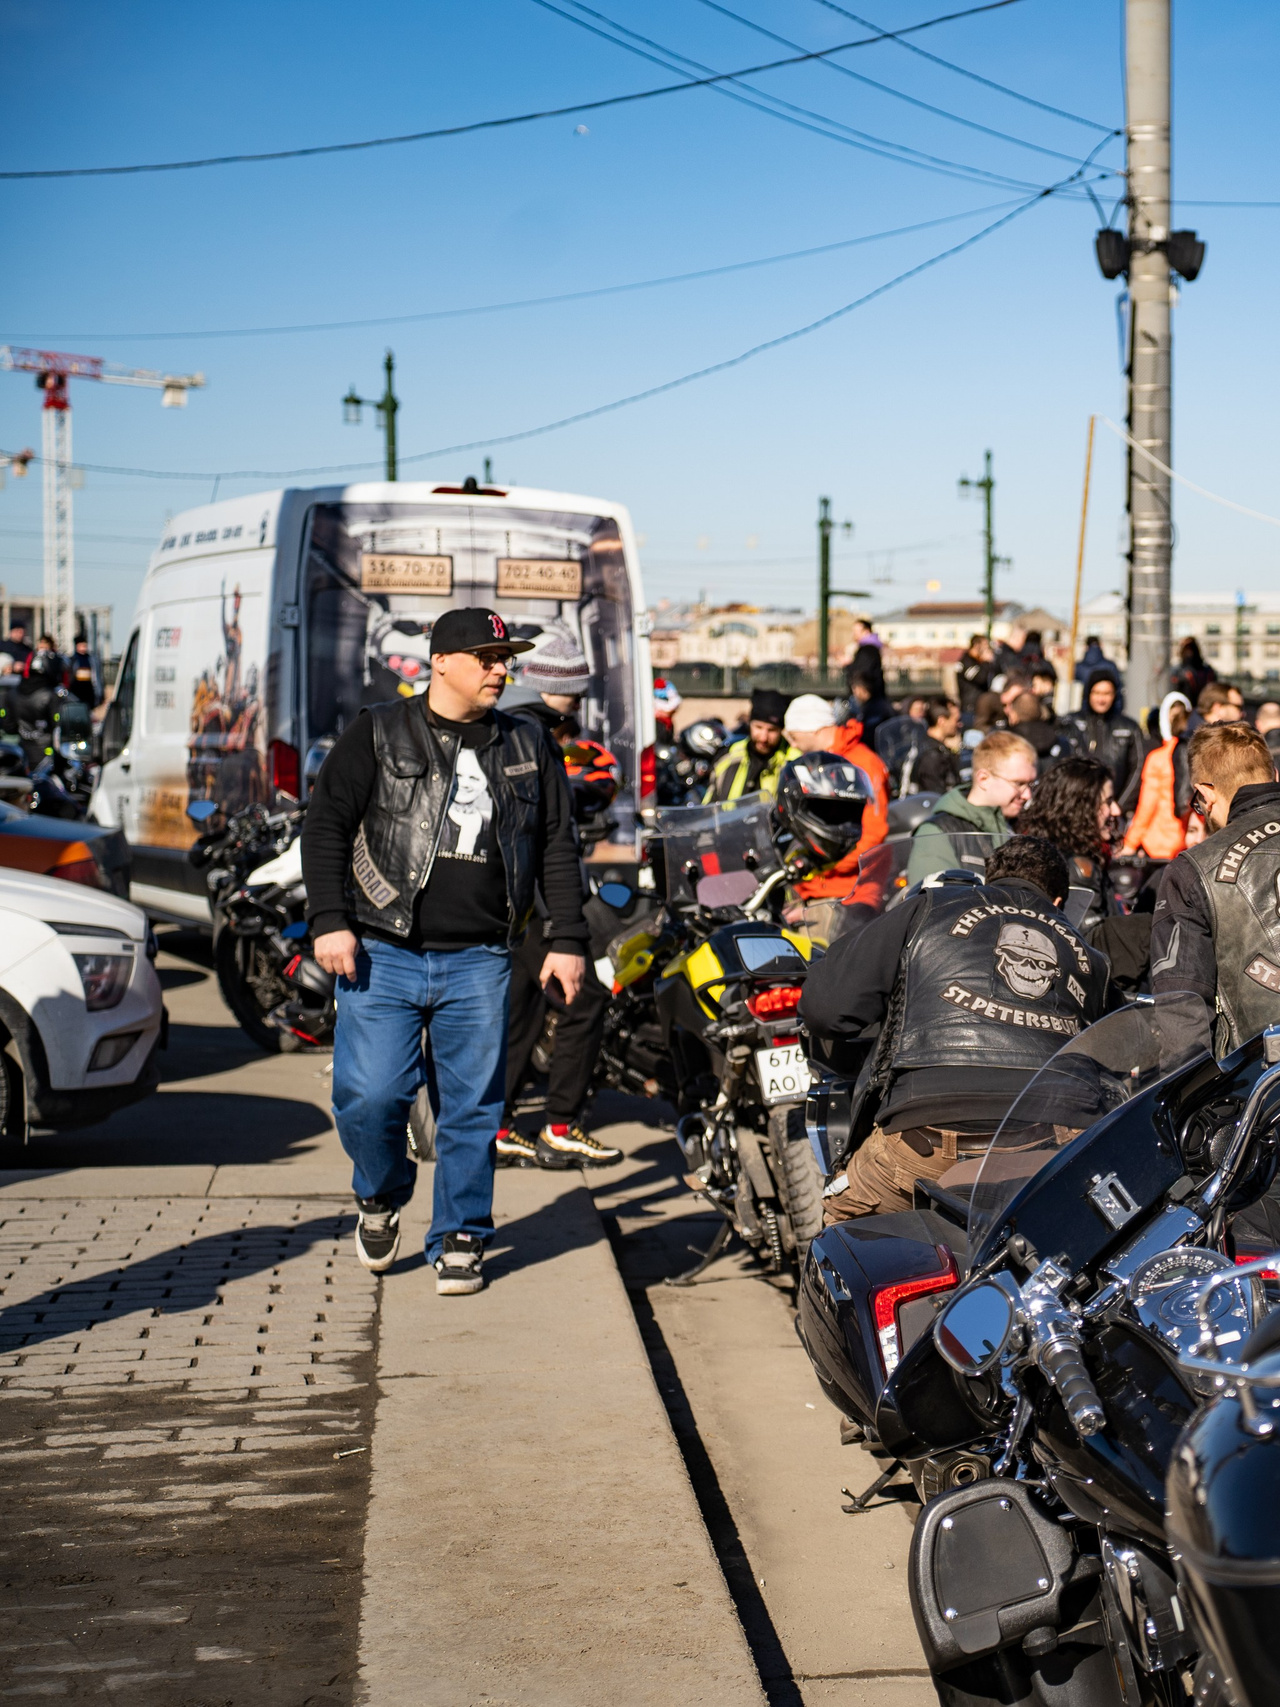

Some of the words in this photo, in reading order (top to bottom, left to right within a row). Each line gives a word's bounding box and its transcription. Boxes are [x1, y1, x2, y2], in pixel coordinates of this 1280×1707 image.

[1219, 843, 1250, 880] THE
[951, 908, 987, 937] THE
[984, 904, 1091, 974] HOOLIGANS
[1068, 981, 1085, 1002] MC
